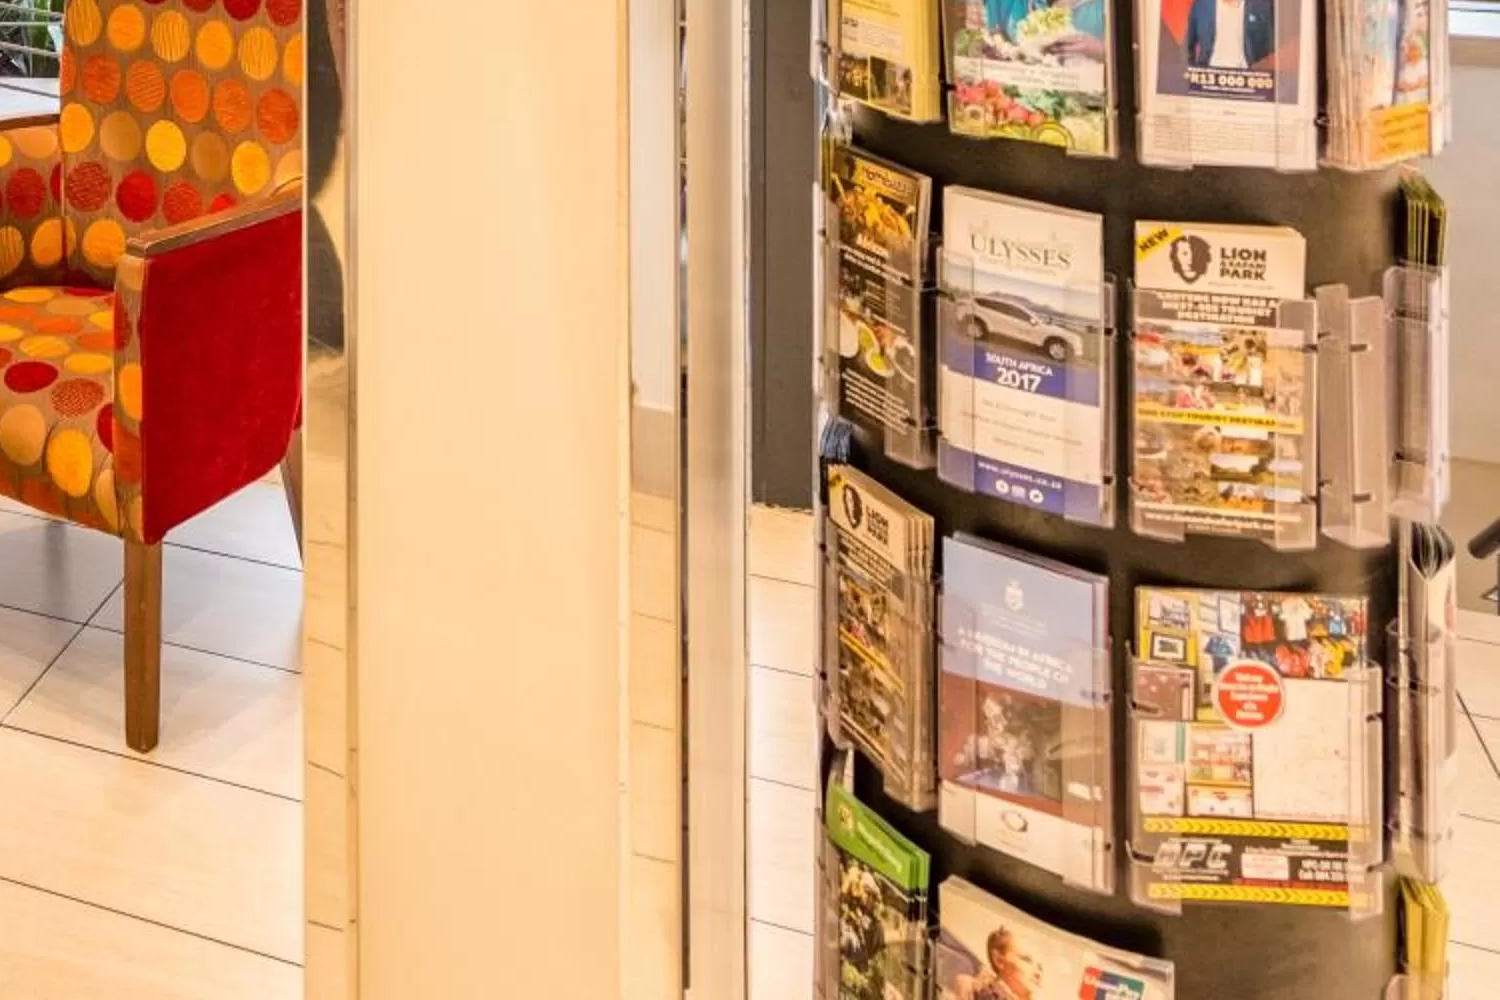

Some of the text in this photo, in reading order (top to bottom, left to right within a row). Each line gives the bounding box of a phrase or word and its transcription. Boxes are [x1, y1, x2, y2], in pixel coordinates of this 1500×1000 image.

[970, 232, 1071, 271] ULYSSES
[1139, 227, 1170, 253] NEW
[1219, 246, 1267, 262] LION
[1219, 268, 1266, 281] PARK
[996, 367, 1042, 393] 2017
